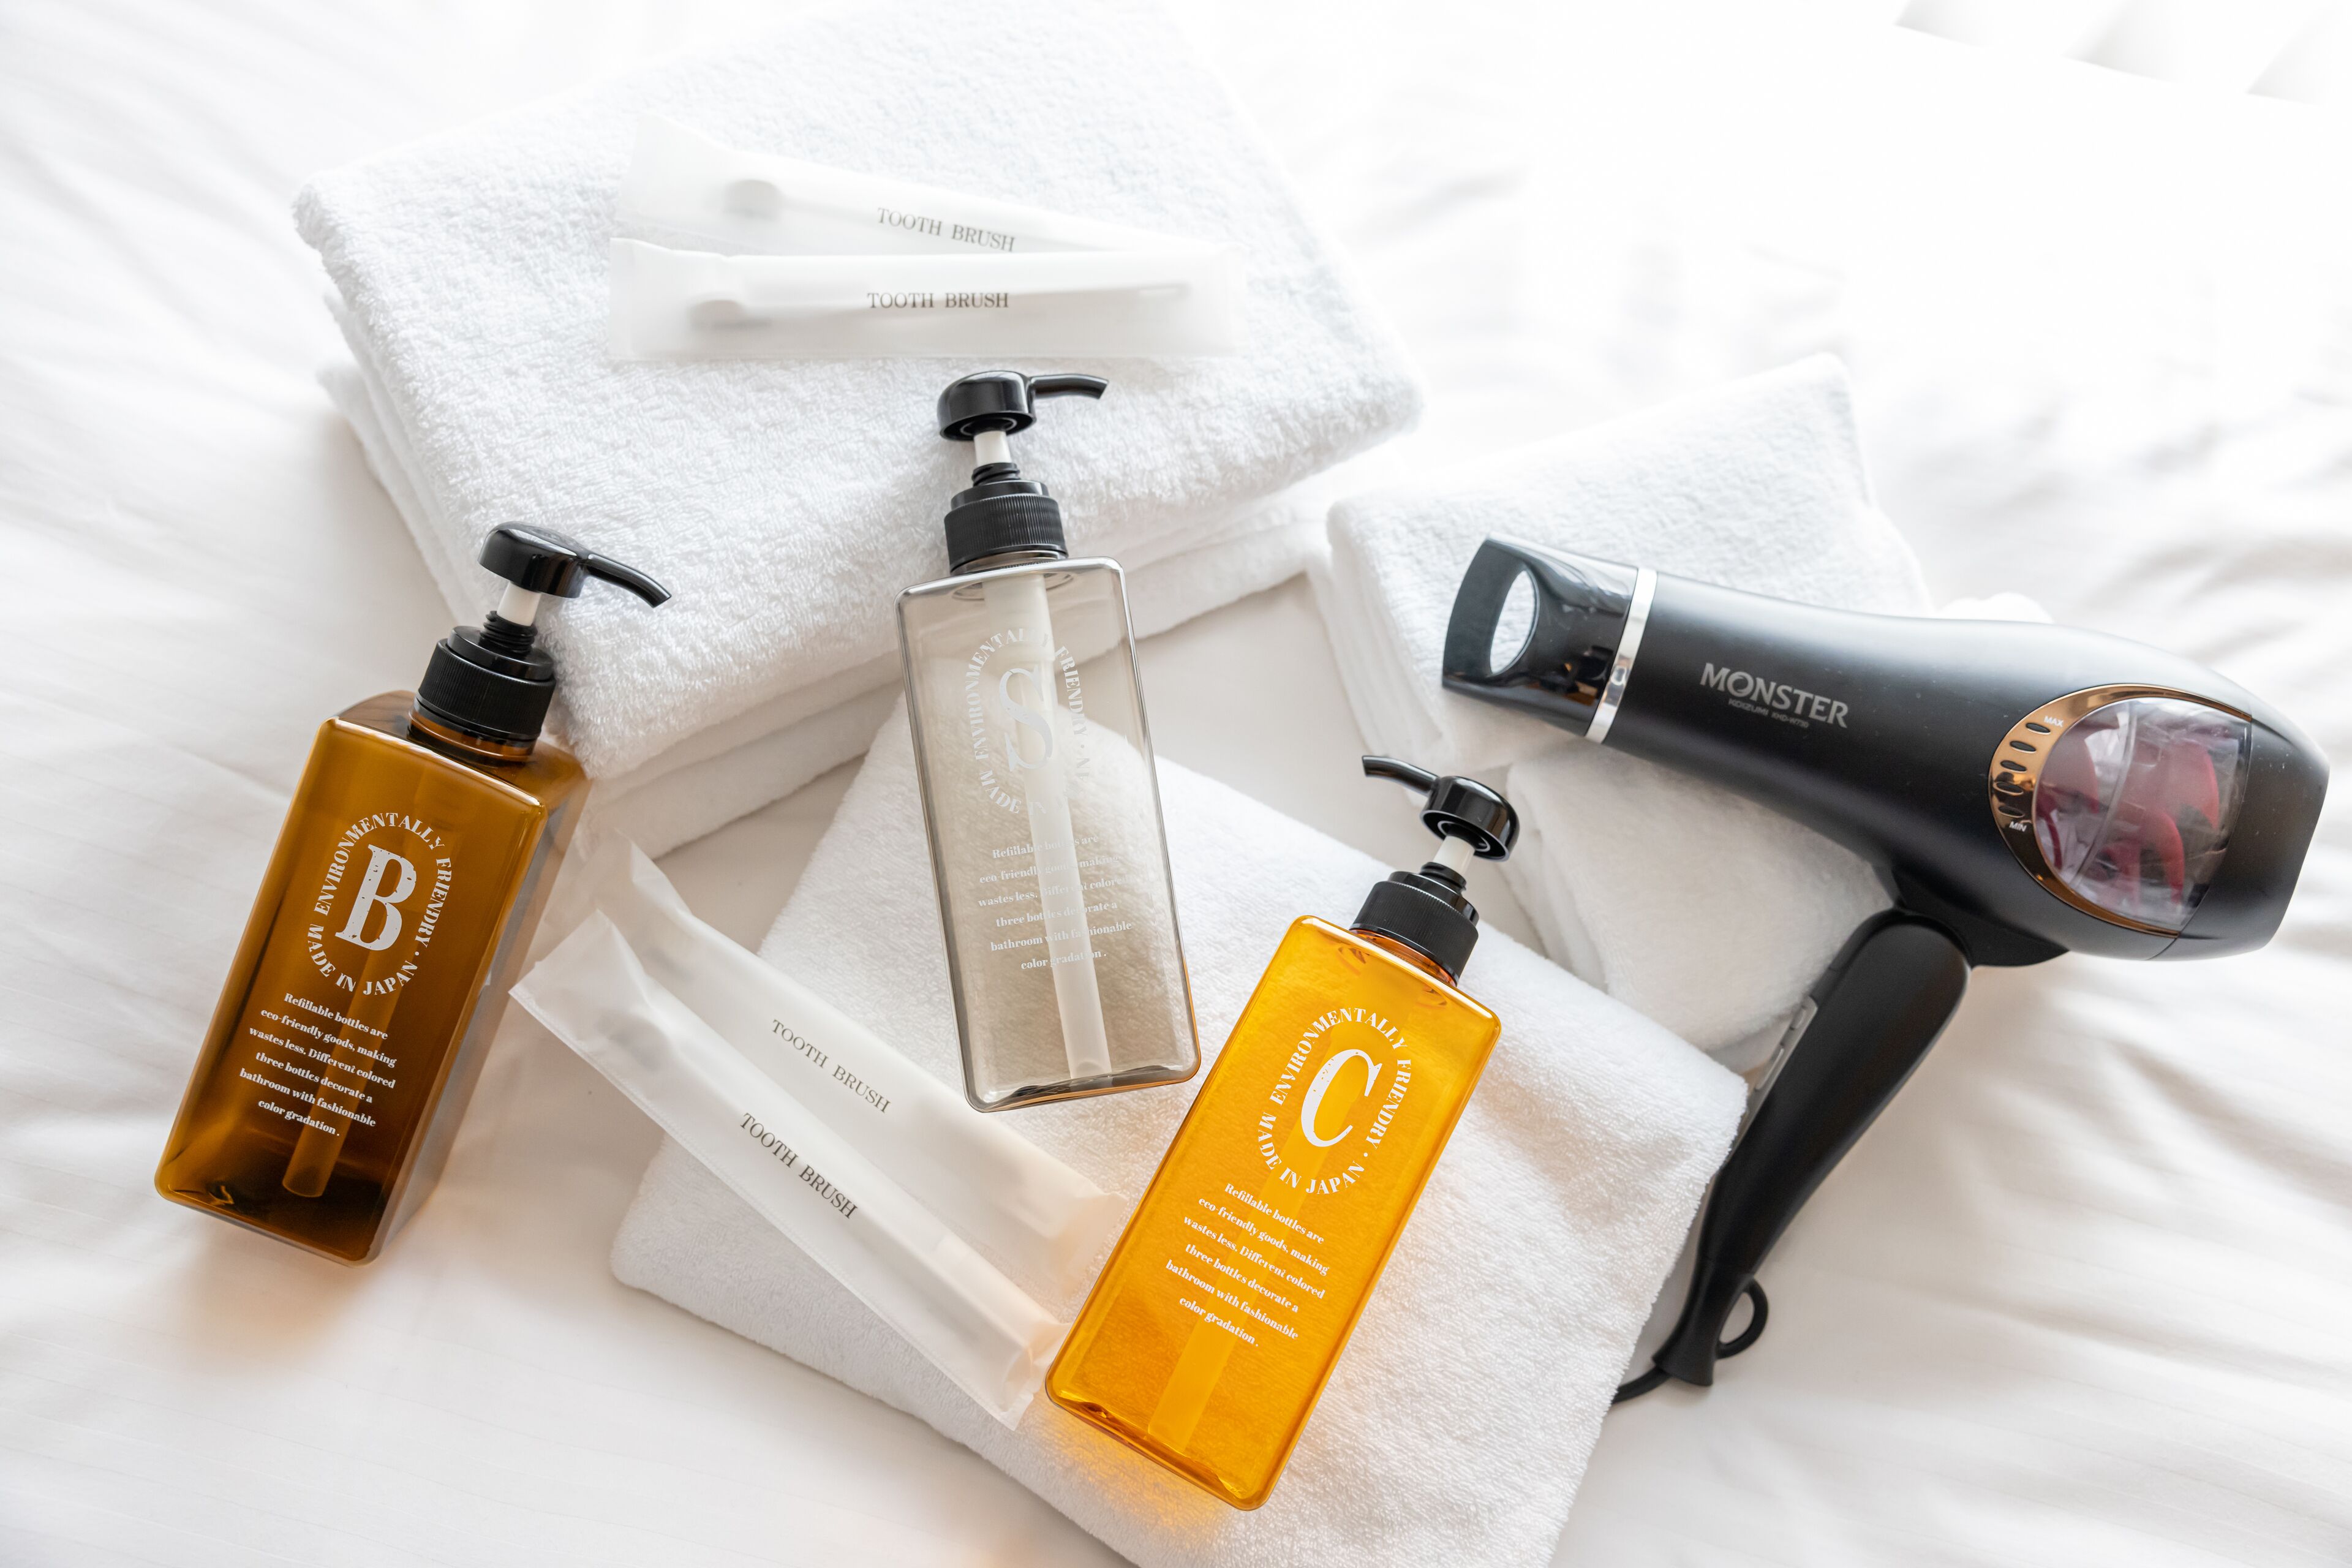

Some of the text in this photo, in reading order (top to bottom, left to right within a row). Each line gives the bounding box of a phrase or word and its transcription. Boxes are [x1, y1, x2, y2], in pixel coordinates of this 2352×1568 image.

[877, 207, 1016, 252] TOOTH BRUSH
[867, 293, 1009, 308] TOOTH BRUSH
[965, 628, 1050, 761] ENVIRONMENTAL
[999, 665, 1053, 772] S
[1700, 662, 1849, 728] MONSTER
[2043, 715, 2064, 728] MAX
[979, 769, 1022, 815] MADE
[992, 843, 1042, 859] Refillabe
[1081, 835, 1099, 845] are
[2008, 821, 2028, 832] MIN
[314, 812, 453, 949] ENVIRONMENTALLY FRIENDRY
[335, 843, 417, 952] B
[978, 895, 1014, 907] wastes
[1016, 891, 1038, 902] less.
[990, 937, 1043, 951] bathroom
[1071, 921, 1133, 938] faionable
[996, 916, 1025, 927] three
[1027, 910, 1062, 922] botles
[307, 923, 418, 997] MADE IN JAPAN
[1020, 958, 1048, 970] color
[260, 1009, 397, 1068] eco-friendly goods, making
[284, 993, 388, 1039] Refillable bottles are
[249, 1028, 396, 1088] wastes less. Different colored
[255, 1052, 284, 1069] three
[284, 1062, 320, 1082] bottles
[320, 1077, 366, 1099] decorate
[772, 1019, 891, 1114] TOOTH BRUSH
[1269, 1007, 1412, 1150] ENVIRONMENTALLY FRIENDRY
[239, 1068, 376, 1126] bathroom with fashionable
[257, 1100, 286, 1118] color
[1300, 1049, 1382, 1148] C
[739, 1112, 858, 1219] TOOTH BRUSH
[1257, 1112, 1366, 1196] MADE IN JAPAN
[1198, 1198, 1330, 1276] eco-friendly goods, making
[1224, 1183, 1324, 1244] Refillable bottles are
[1184, 1216, 1325, 1299] wastes less. Different colored
[1185, 1244, 1298, 1313] three bottles decorate a
[1166, 1259, 1298, 1339] bathroom with fashionable
[1178, 1296, 1207, 1316] color
